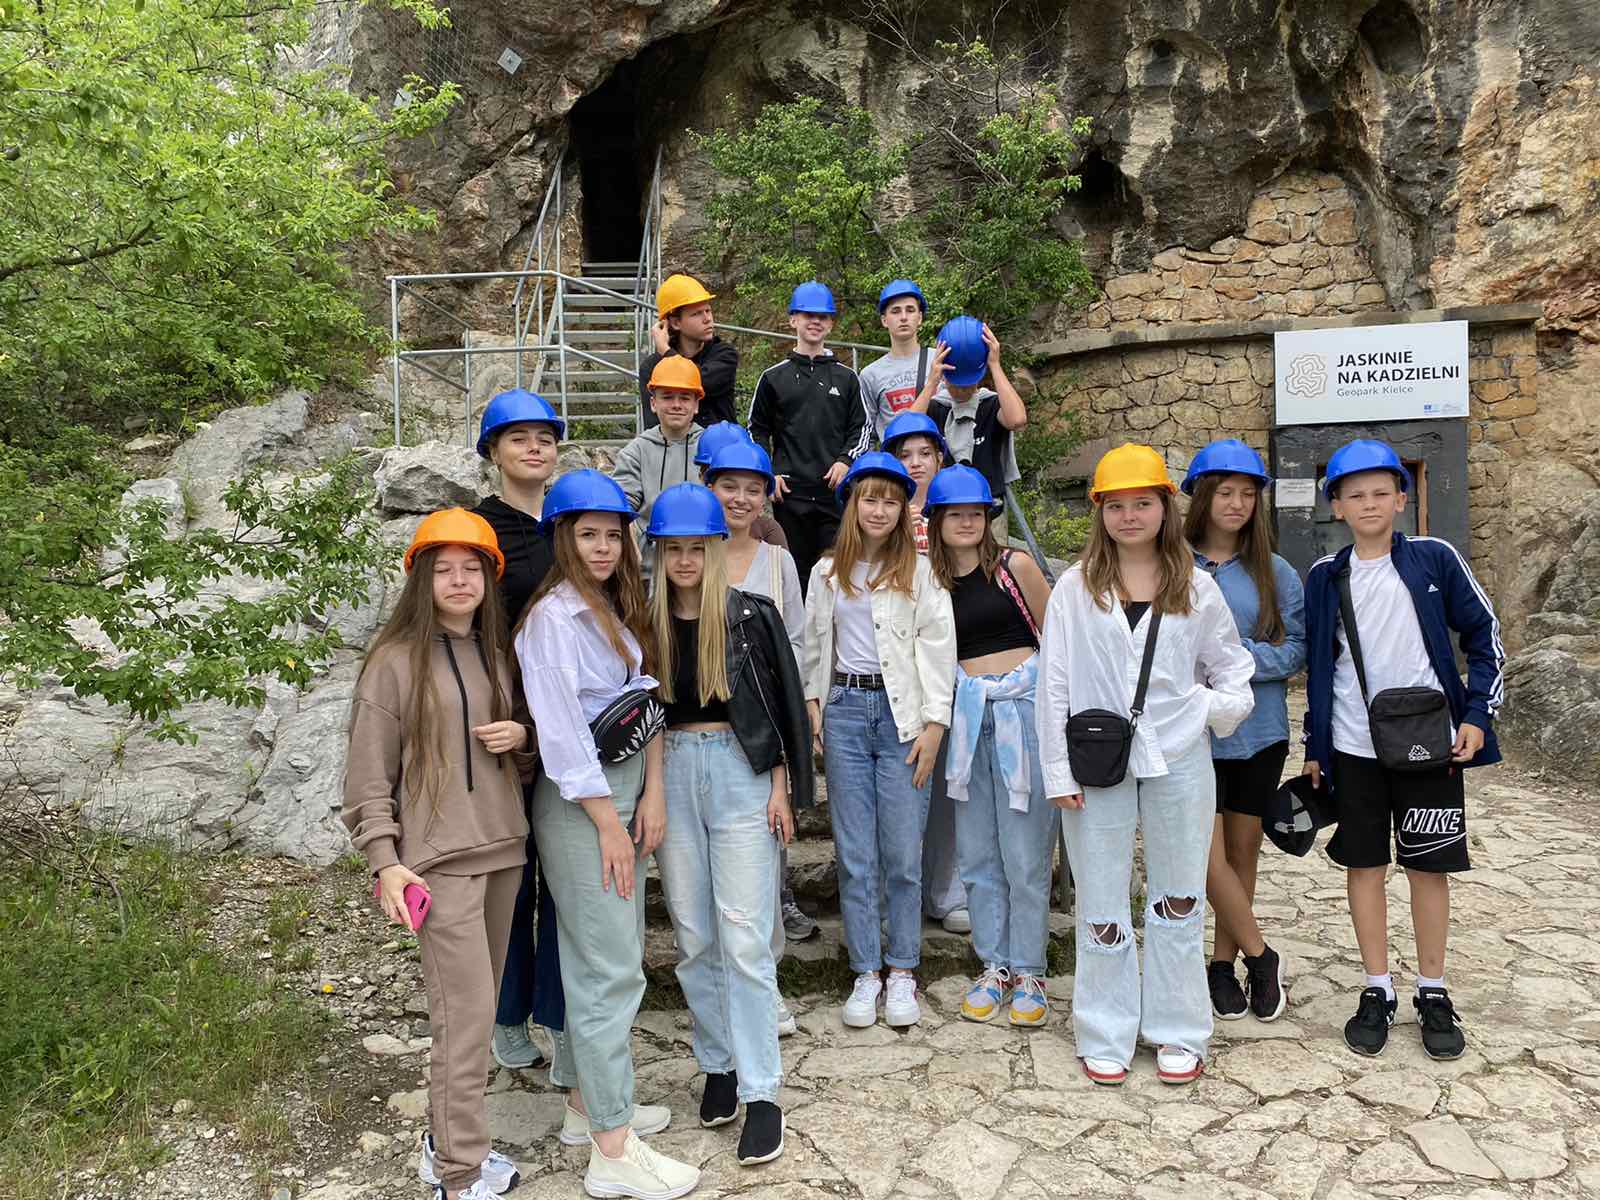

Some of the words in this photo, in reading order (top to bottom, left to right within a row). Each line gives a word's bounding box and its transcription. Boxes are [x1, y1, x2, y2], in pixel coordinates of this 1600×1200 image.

[1337, 351, 1413, 367] JASKINIE
[1338, 371, 1362, 384] NA
[1367, 365, 1459, 382] KADZIELNI
[1336, 386, 1379, 397] Geopark
[1383, 384, 1414, 395] Kielce
[1401, 808, 1463, 834] NIKE
